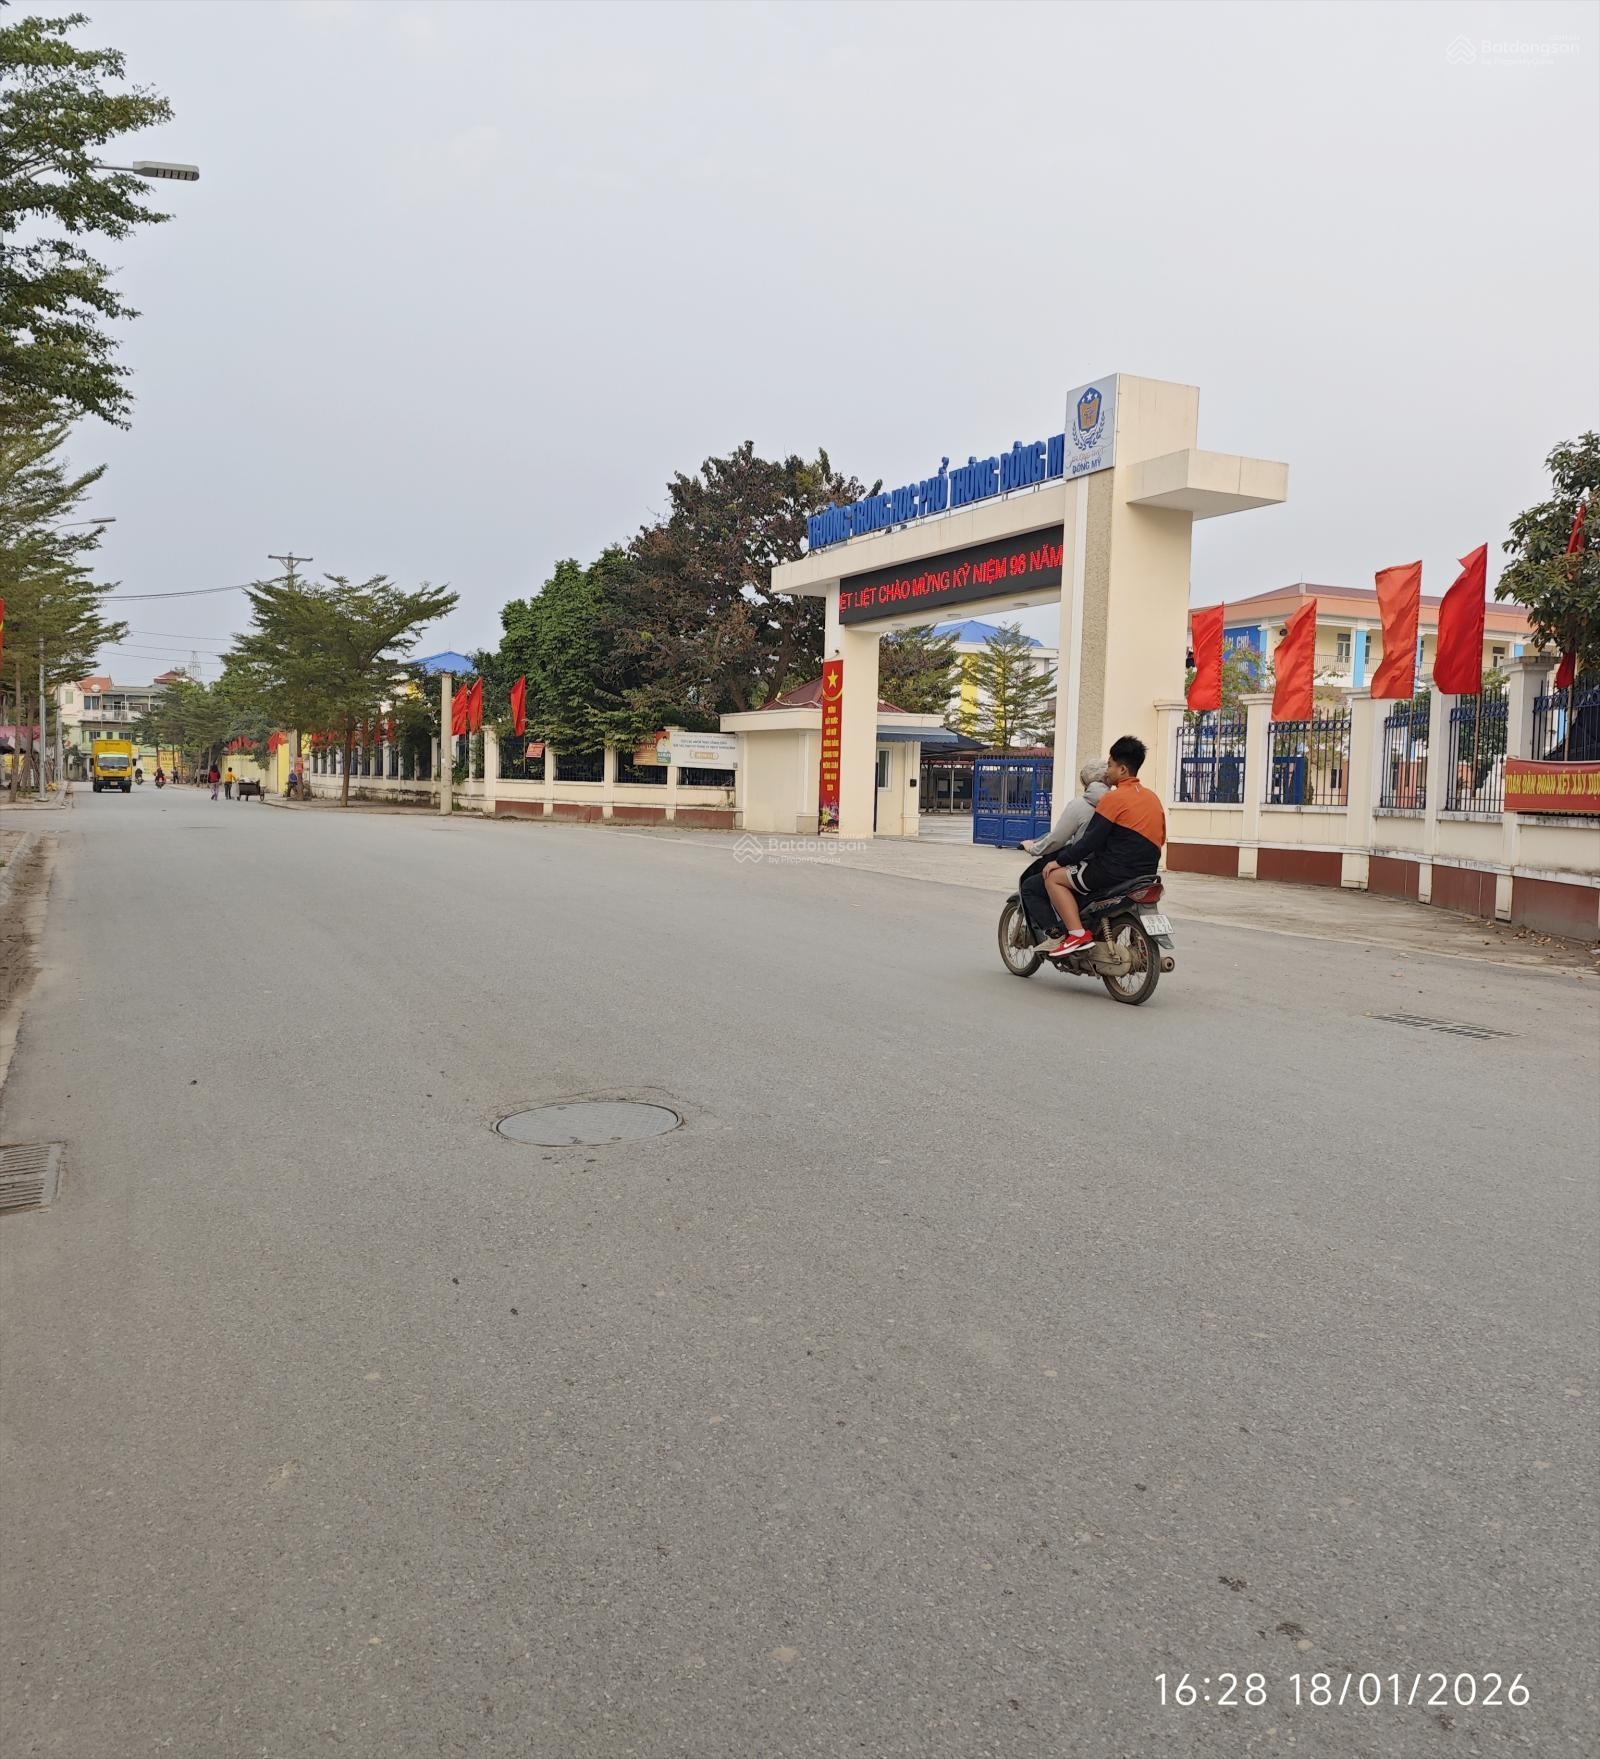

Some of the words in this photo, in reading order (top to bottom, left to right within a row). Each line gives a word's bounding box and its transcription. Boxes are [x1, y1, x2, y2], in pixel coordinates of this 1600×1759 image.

[851, 491, 891, 537] TRUNG
[892, 483, 919, 529] HỌC
[919, 457, 949, 516] PHỔ
[949, 456, 999, 507] THÔNG
[1047, 433, 1066, 478] M
[879, 579, 911, 604] CHÀO
[912, 571, 950, 597] MỪNG
[973, 557, 1007, 585] NIỆM
[1029, 543, 1064, 572] NĂM
